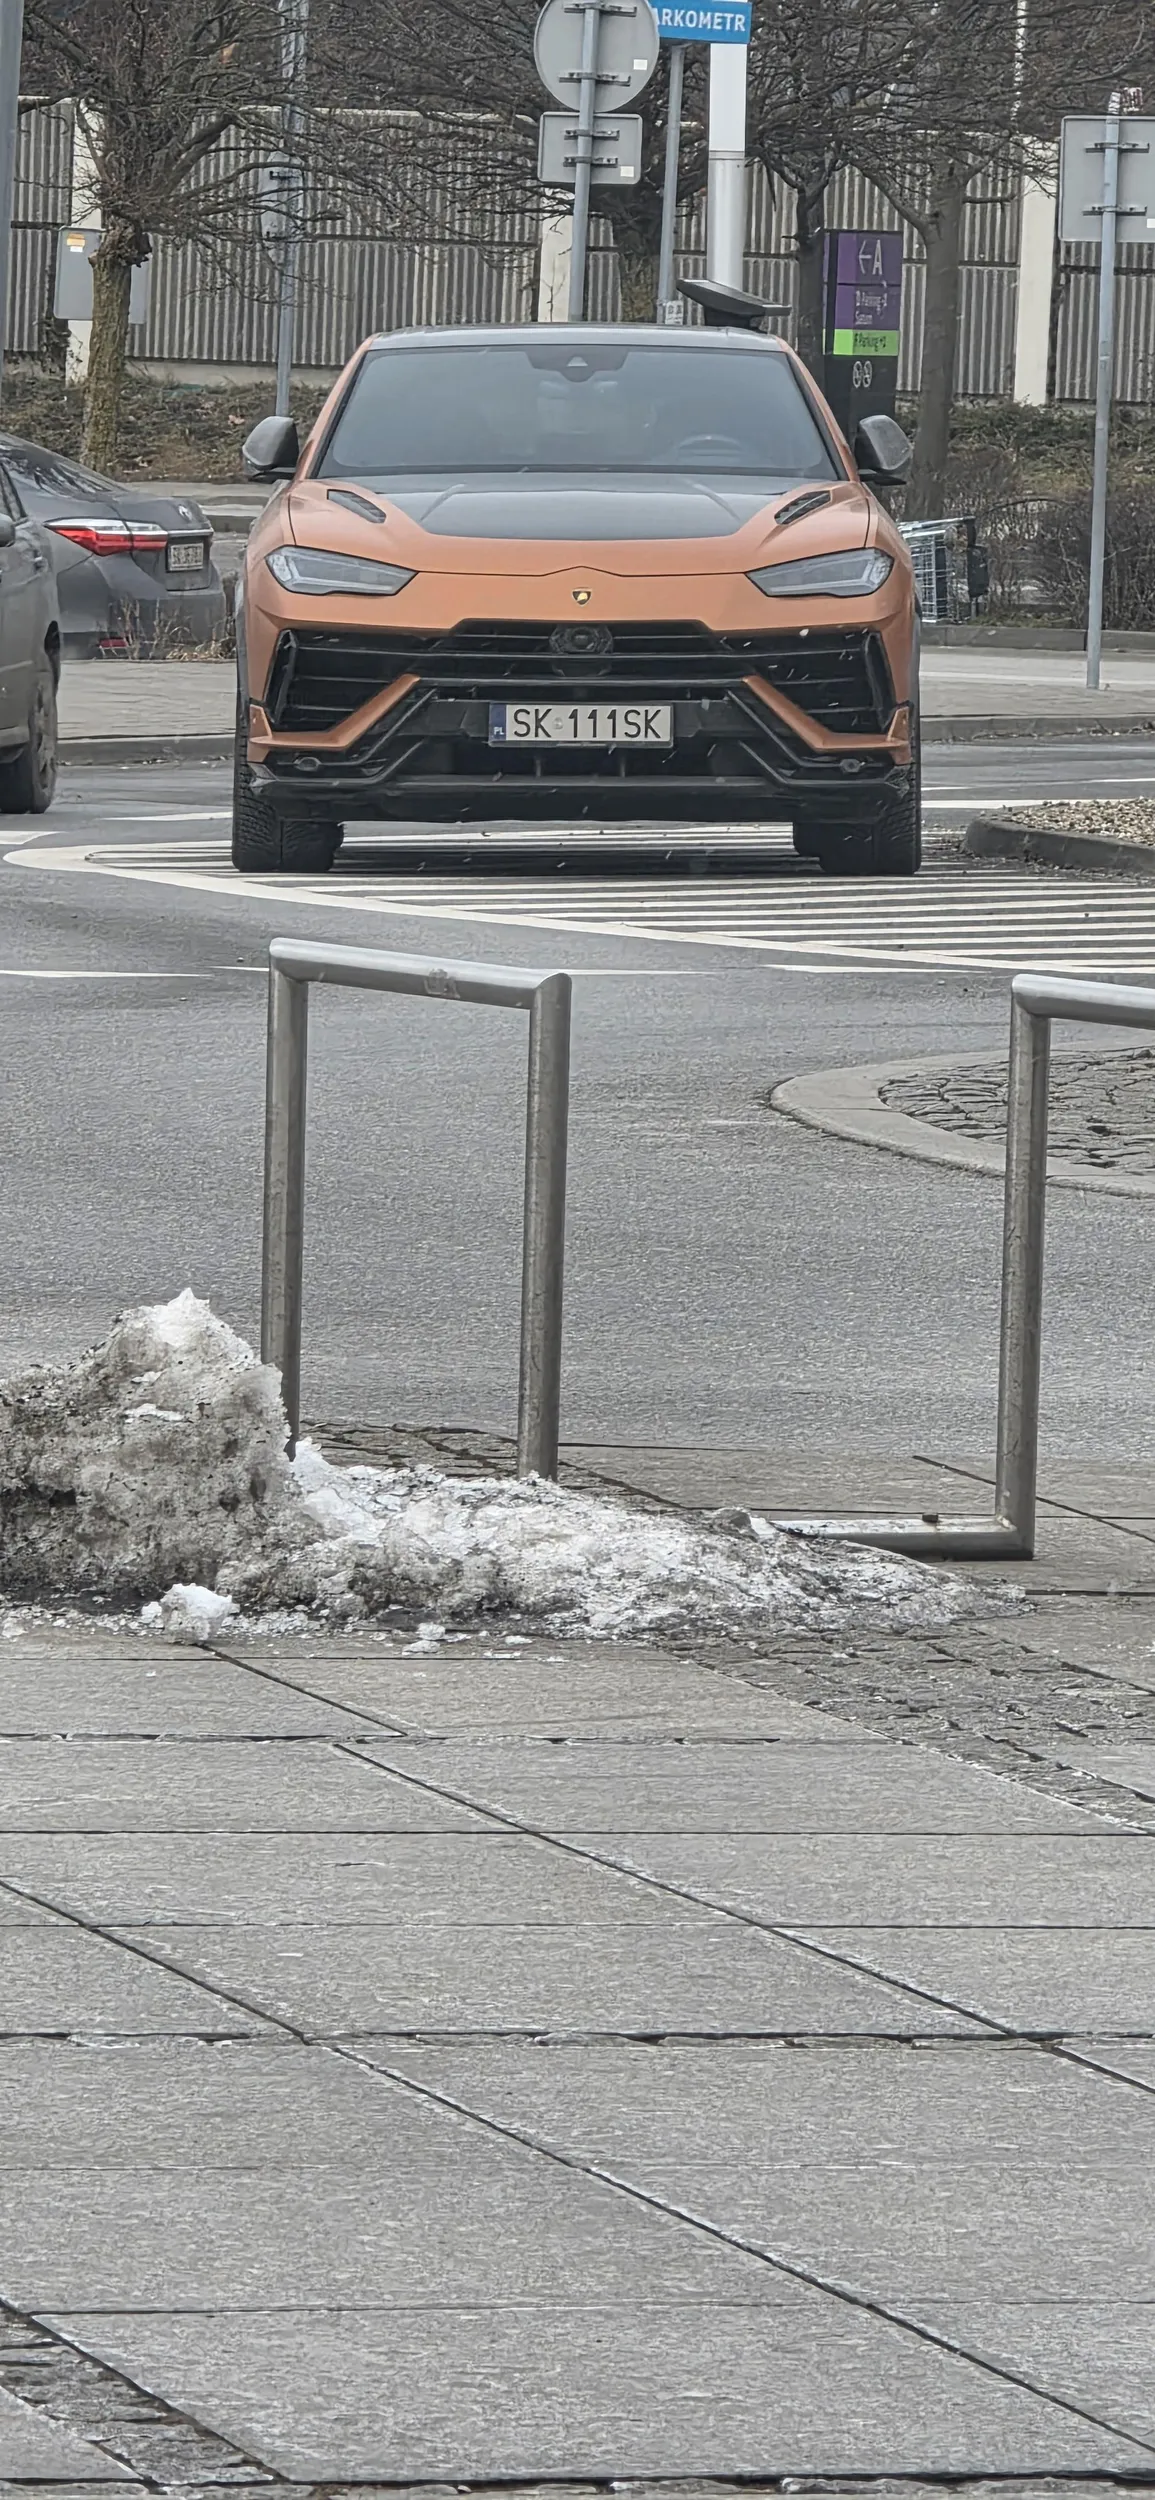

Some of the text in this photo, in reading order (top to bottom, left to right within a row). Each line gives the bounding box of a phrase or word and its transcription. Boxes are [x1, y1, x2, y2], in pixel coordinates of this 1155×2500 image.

[651, 8, 746, 32] ARKOMETR
[871, 239, 883, 275] A
[493, 726, 505, 736] PL
[513, 708, 661, 739] SK 111SK
